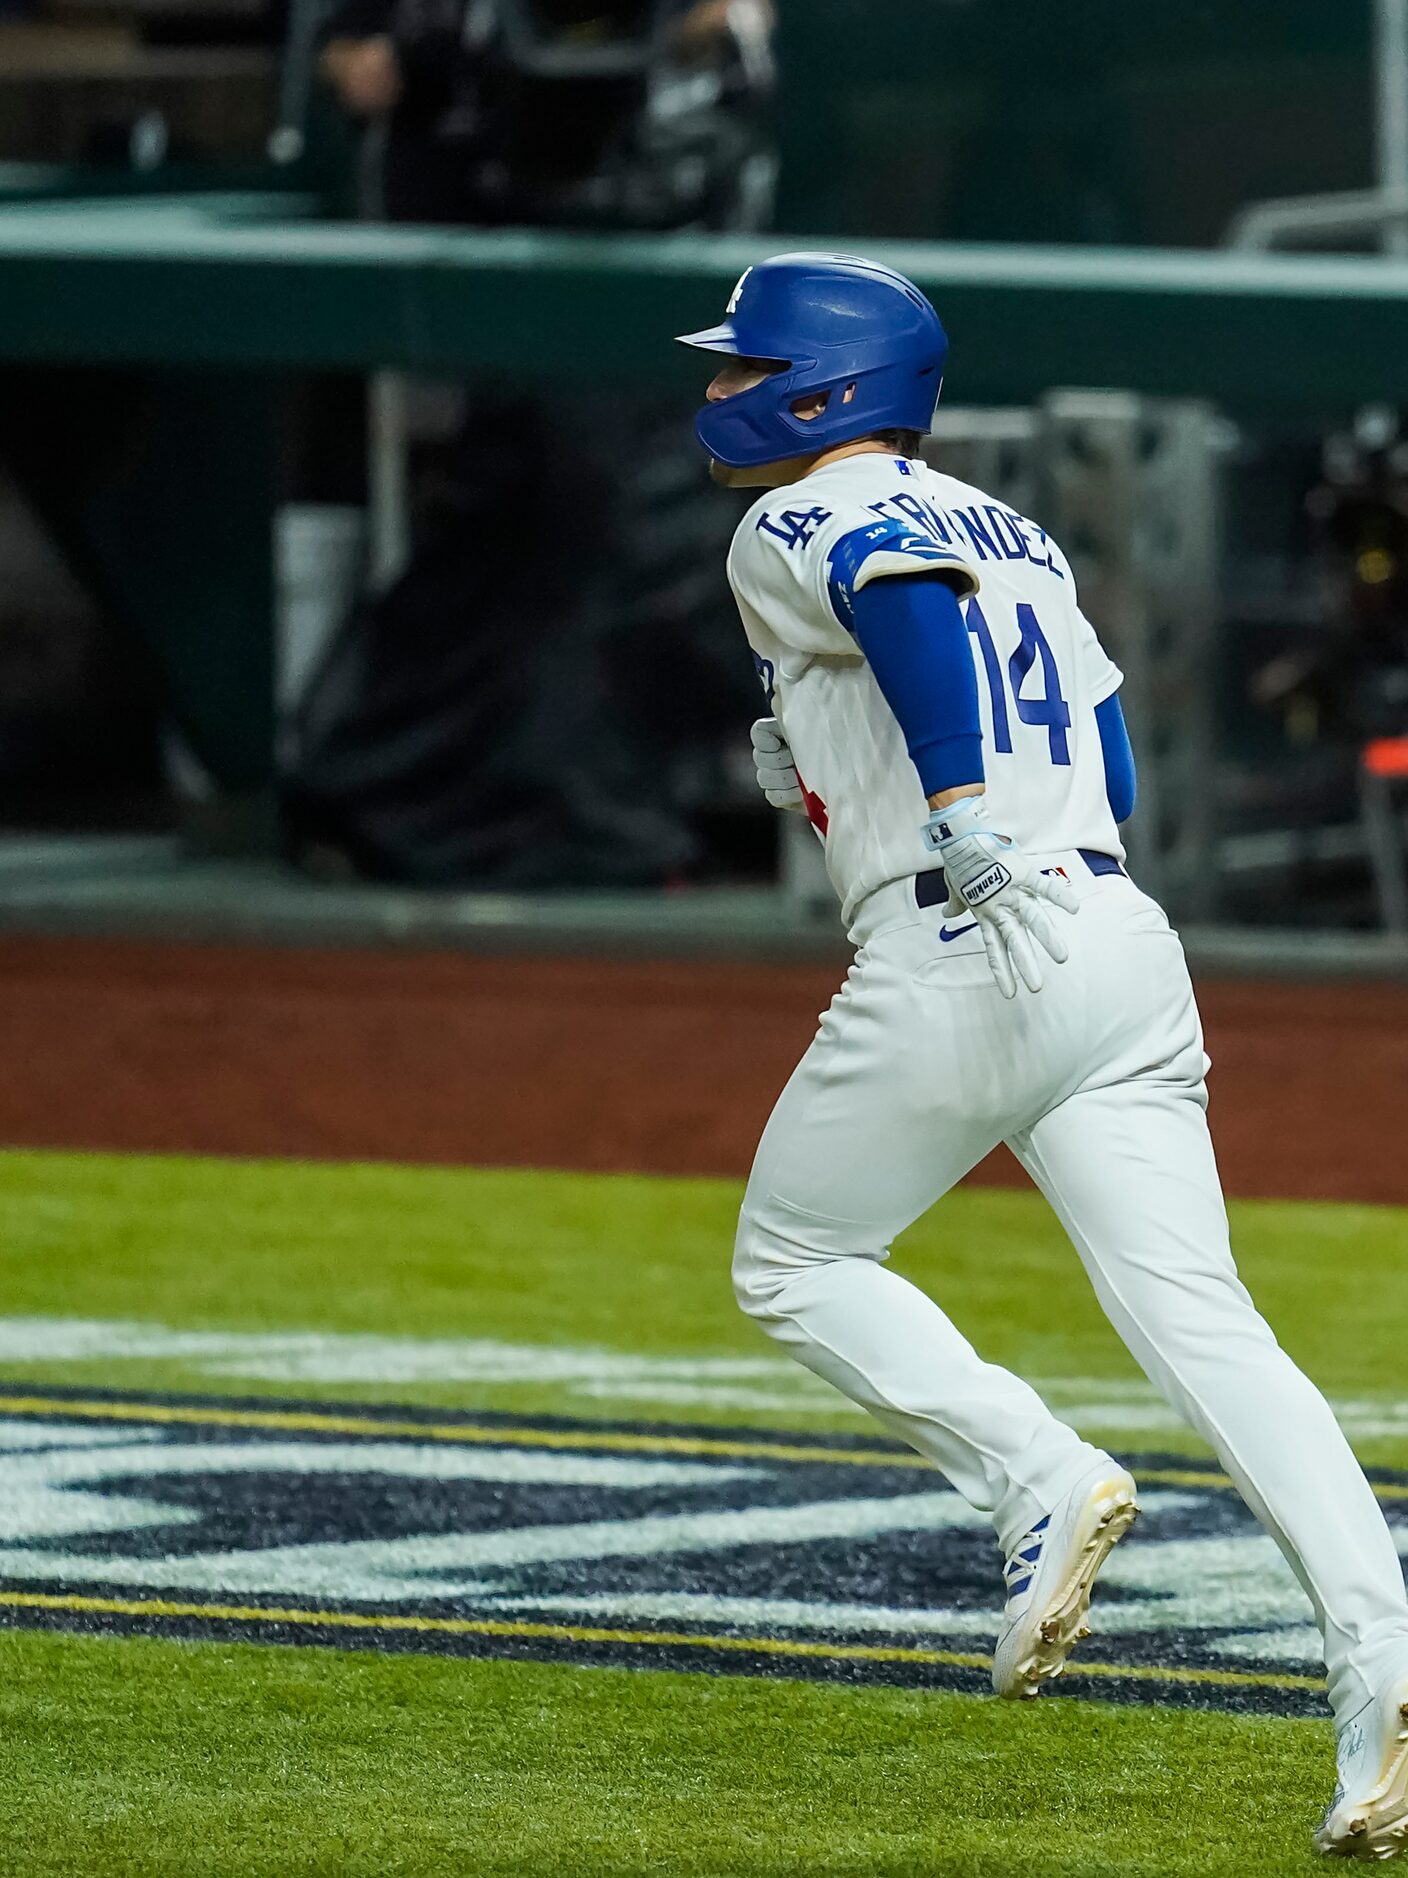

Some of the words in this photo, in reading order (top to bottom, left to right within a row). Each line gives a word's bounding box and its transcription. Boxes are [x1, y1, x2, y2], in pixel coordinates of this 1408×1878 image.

[756, 506, 832, 550] LA
[860, 492, 1066, 580] RNNDEZ
[966, 595, 1072, 766] 14
